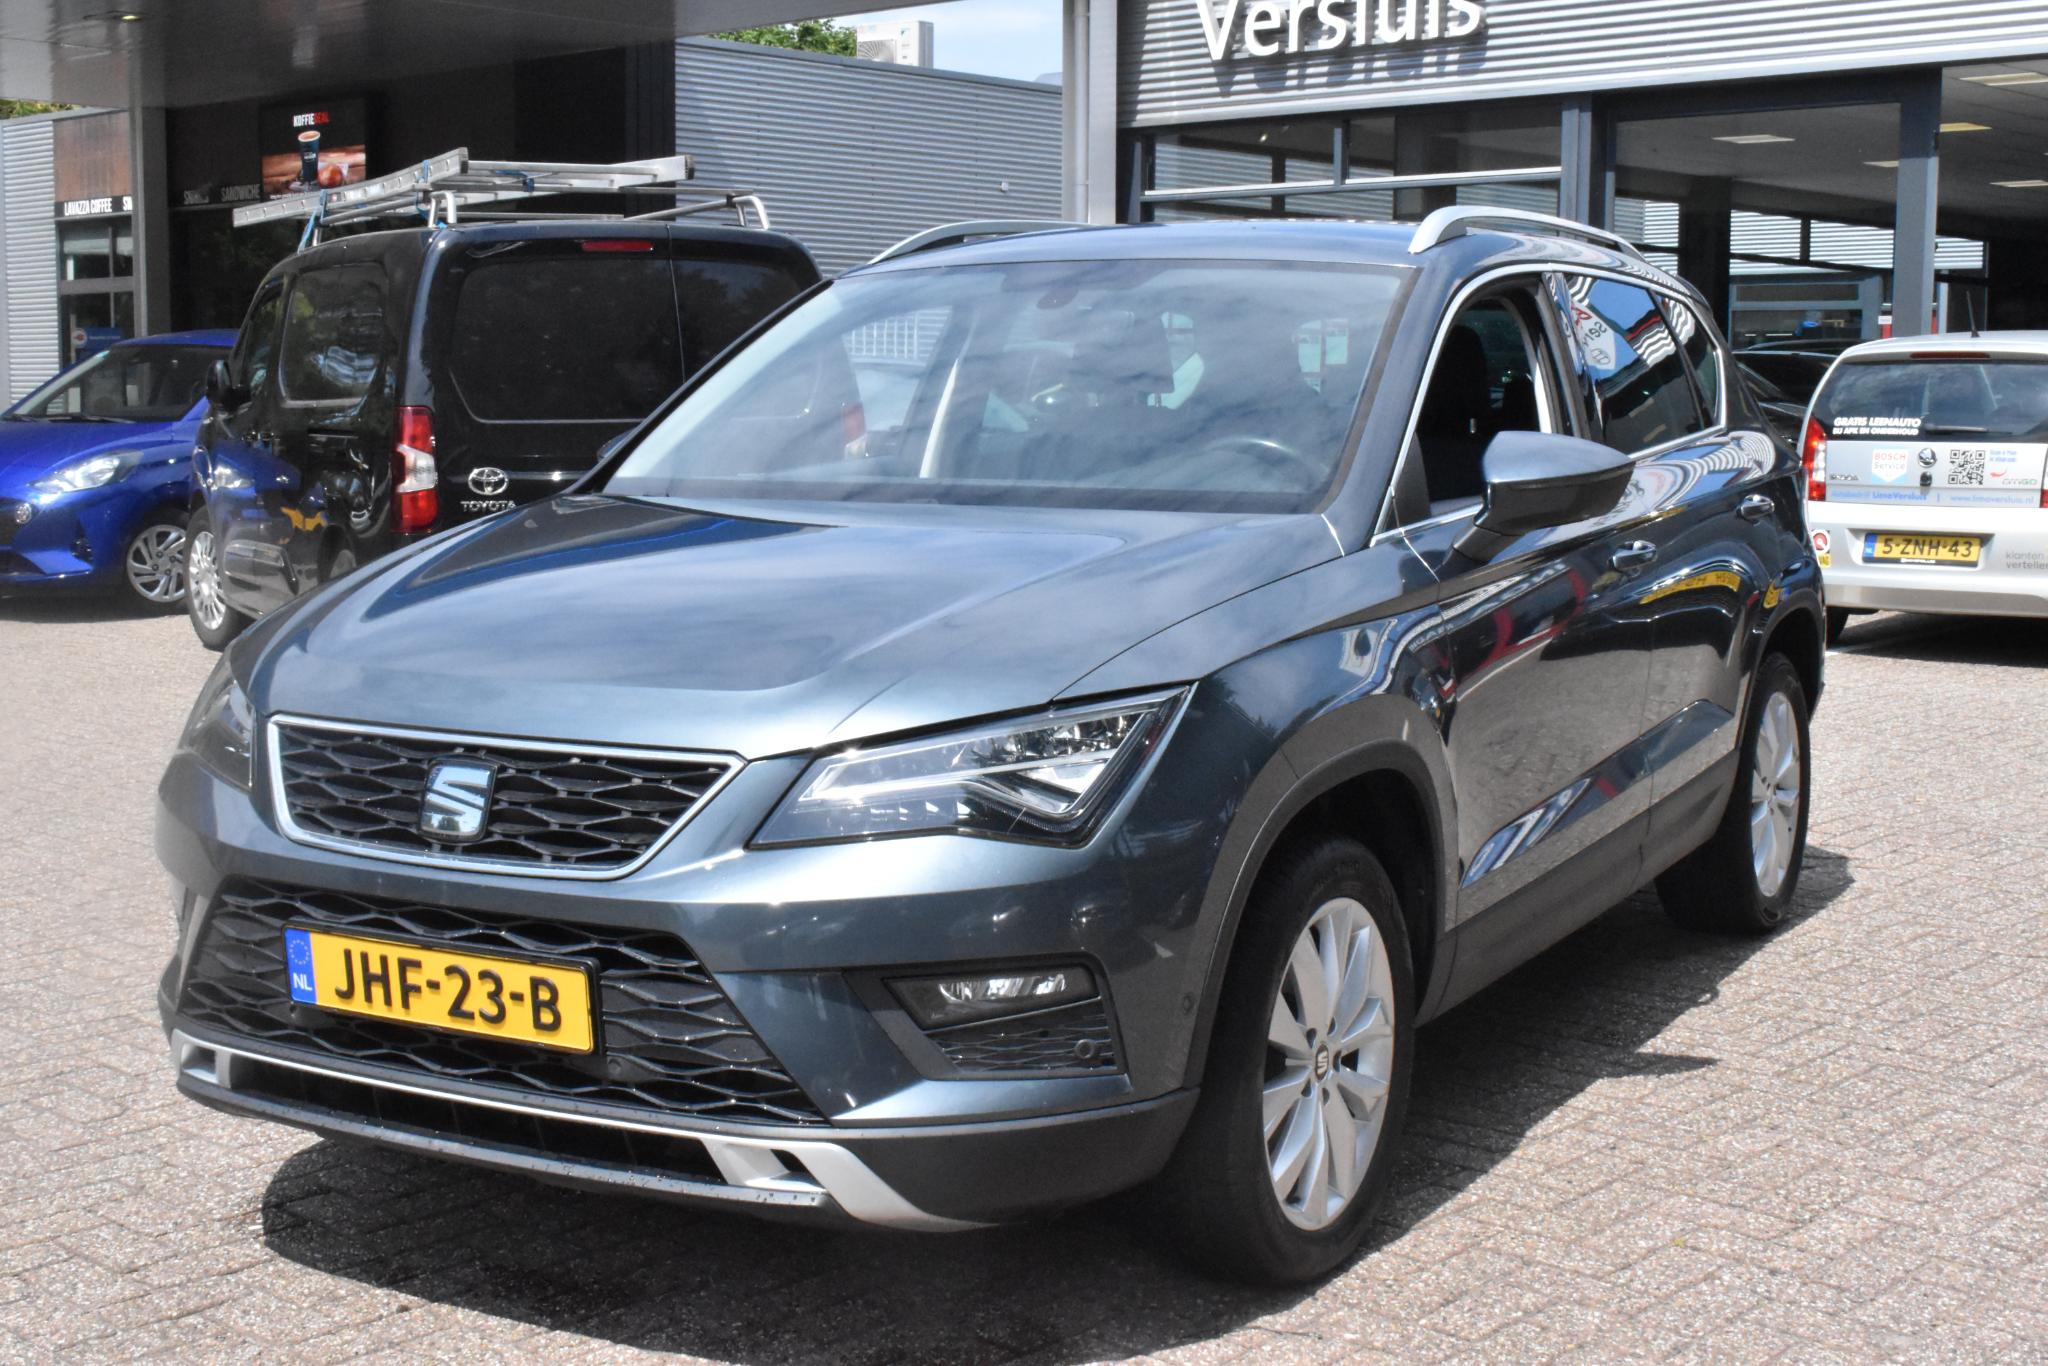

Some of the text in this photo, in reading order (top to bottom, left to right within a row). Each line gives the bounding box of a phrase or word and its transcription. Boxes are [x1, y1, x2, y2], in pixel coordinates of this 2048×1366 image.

[1198, 0, 1482, 61] Versluis
[64, 200, 90, 216] LAVAZZA
[90, 198, 112, 213] COFFEE
[1833, 416, 1921, 428] GRATIS LEENAUTO
[1874, 452, 1906, 461] BOSCH
[1873, 461, 1906, 470] Service
[460, 500, 517, 513] TOYOTA
[1882, 538, 1973, 558] 5-ZNH-43
[293, 947, 562, 1032] NL JHF-23-B
